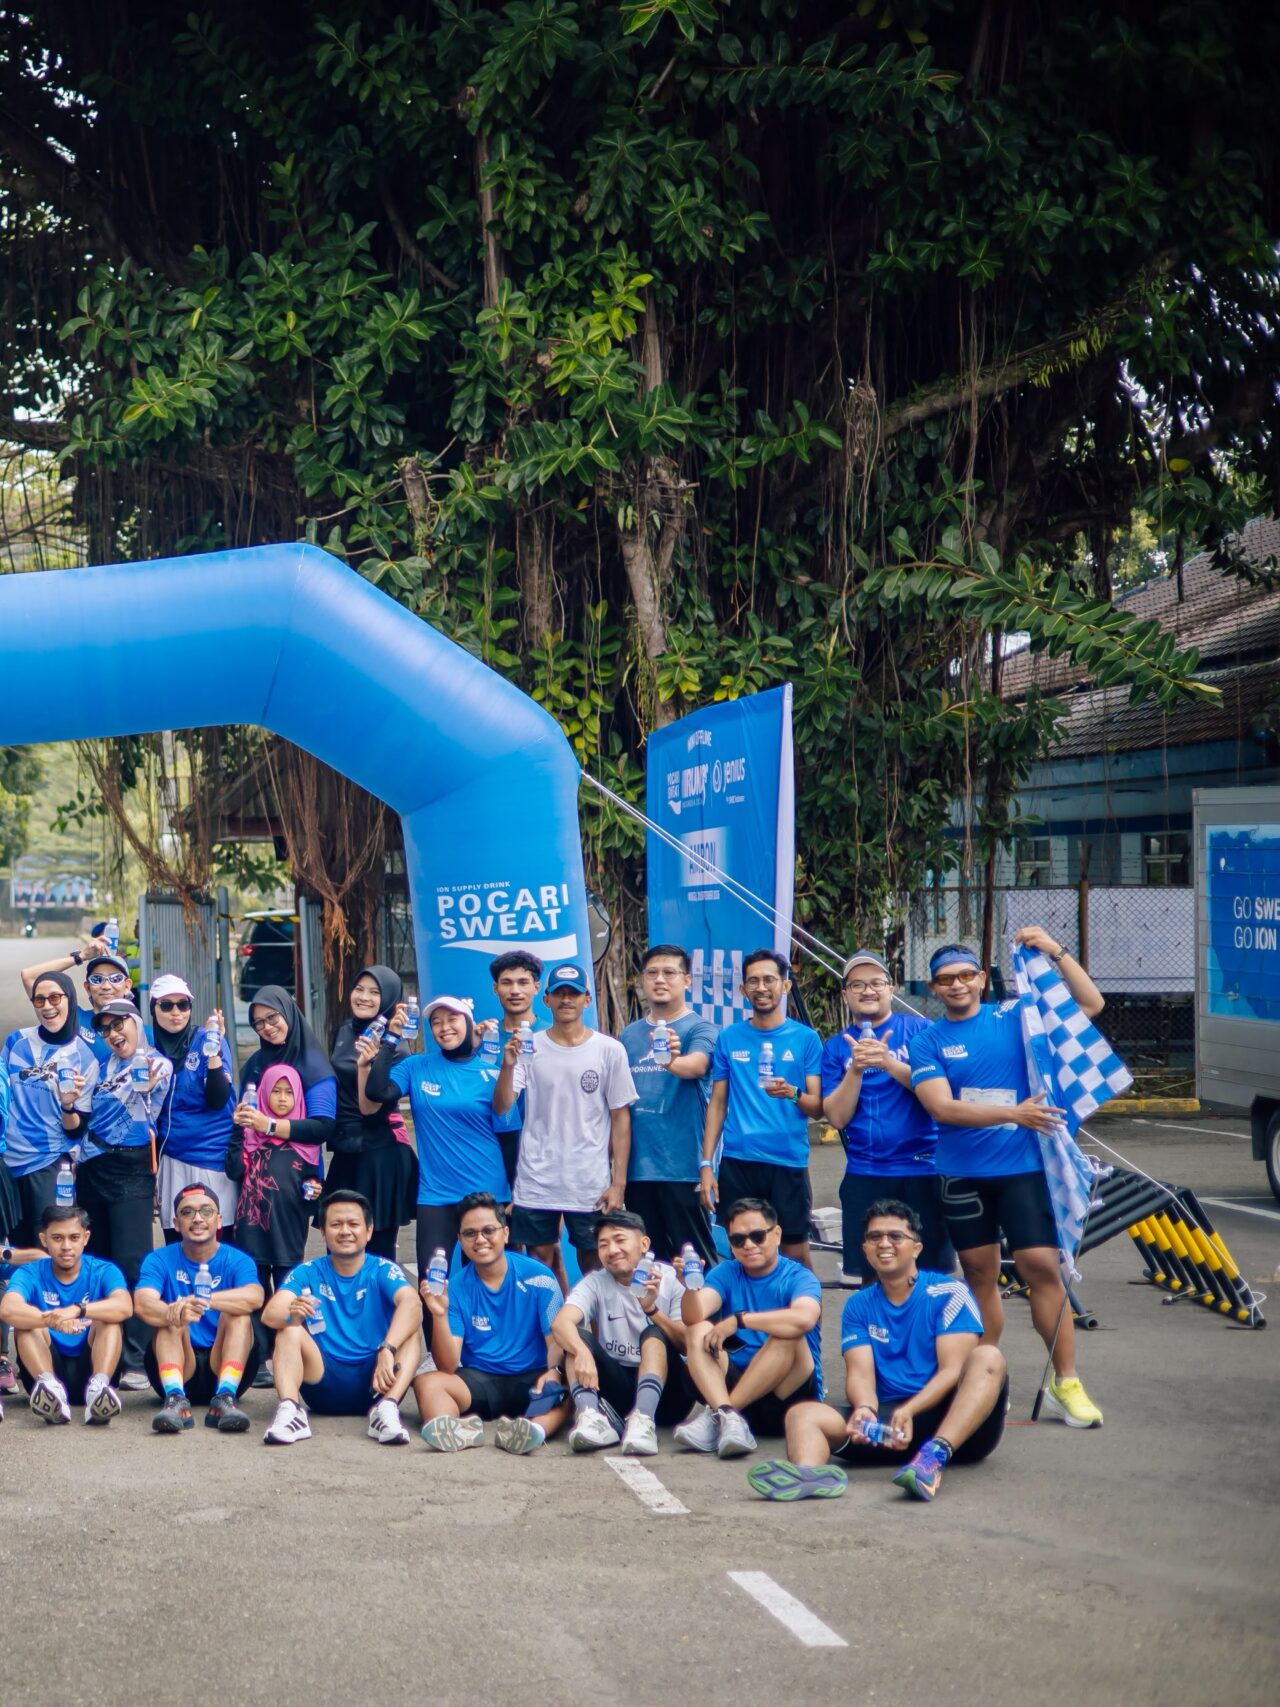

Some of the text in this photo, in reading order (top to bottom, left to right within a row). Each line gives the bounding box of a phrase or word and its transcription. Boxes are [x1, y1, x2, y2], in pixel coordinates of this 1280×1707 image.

[723, 757, 746, 792] jenius
[452, 884, 481, 892] SUPPLY
[483, 880, 511, 889] DRINK
[437, 884, 569, 917] POCARI
[1233, 896, 1252, 919] GO
[440, 908, 561, 939] SWEAT
[1234, 926, 1277, 951] GO ION
